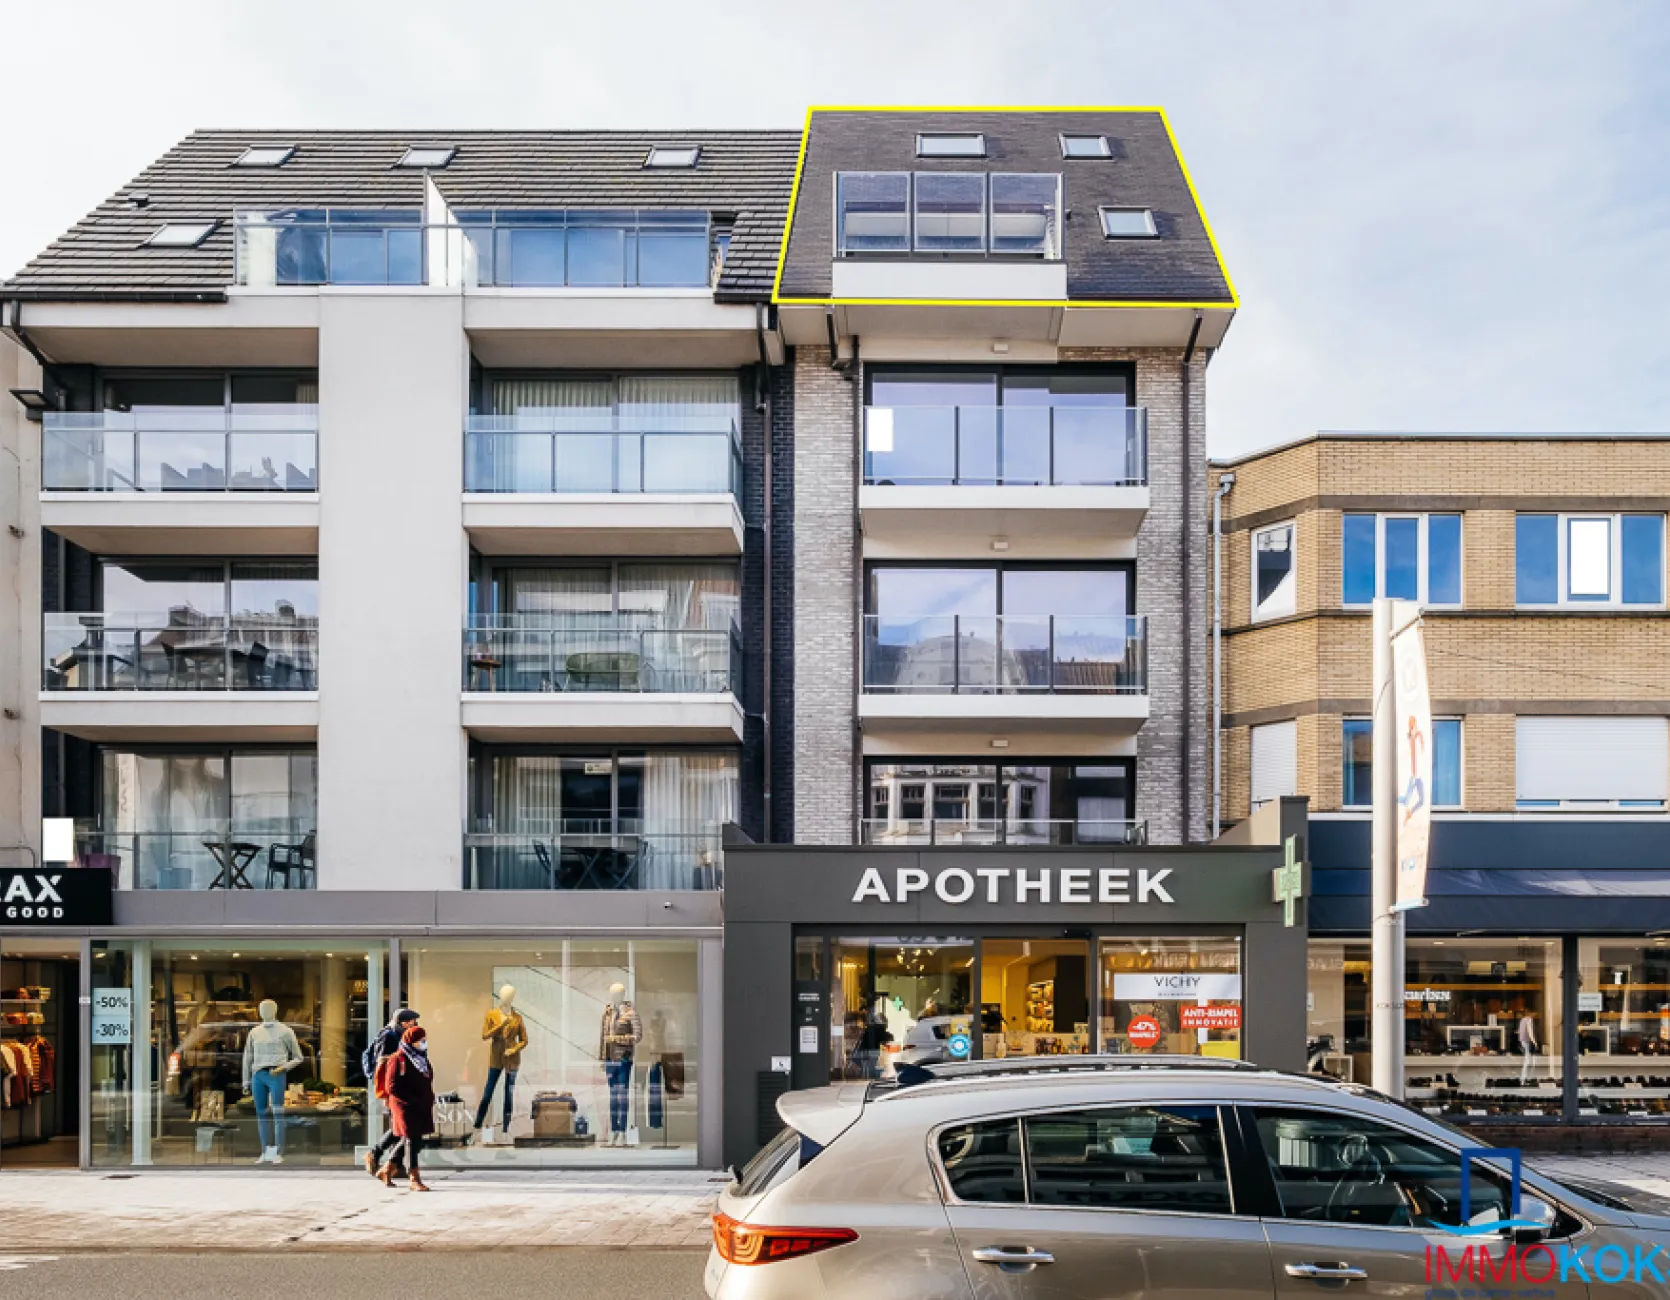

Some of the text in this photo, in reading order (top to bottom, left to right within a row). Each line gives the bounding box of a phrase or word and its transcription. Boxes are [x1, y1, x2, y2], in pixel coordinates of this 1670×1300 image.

[0, 875, 62, 902] AX
[851, 868, 1175, 903] APOTHEEK
[6, 906, 64, 918] GOOD
[1154, 976, 1200, 988] VICHY
[96, 997, 129, 1007] -50%
[96, 1023, 129, 1036] -30%
